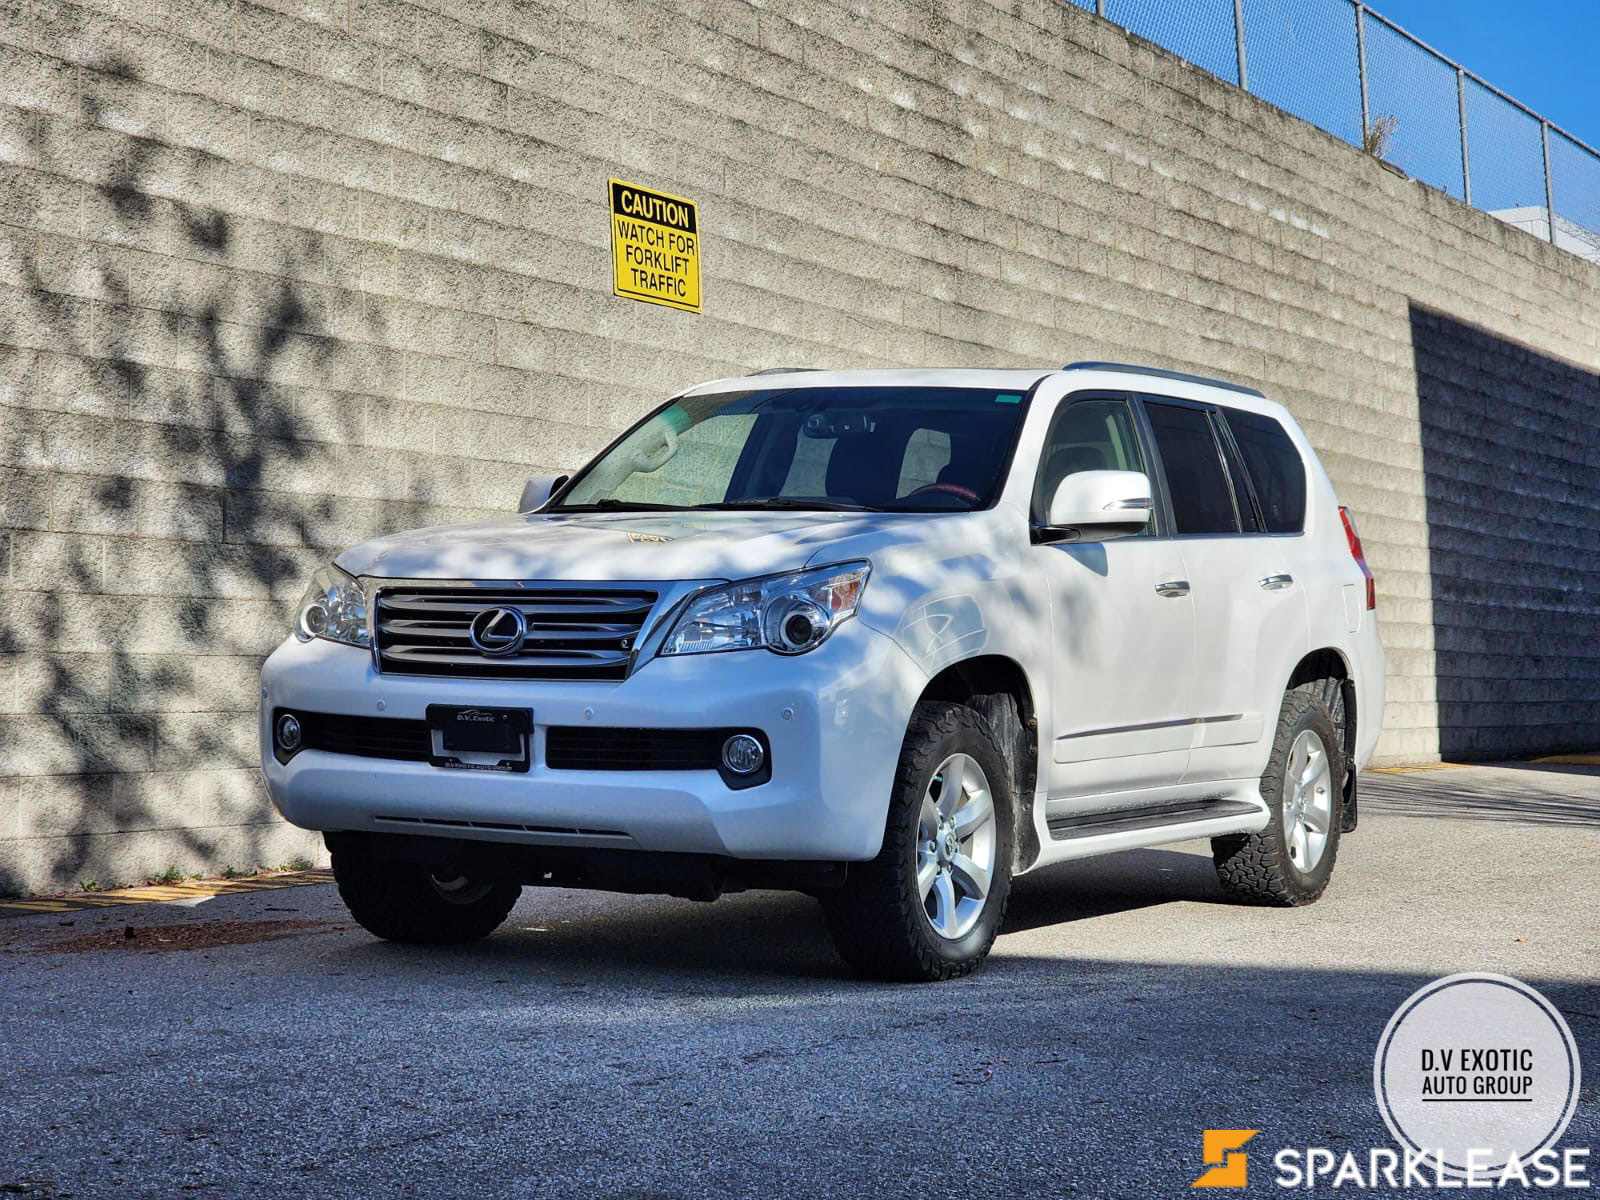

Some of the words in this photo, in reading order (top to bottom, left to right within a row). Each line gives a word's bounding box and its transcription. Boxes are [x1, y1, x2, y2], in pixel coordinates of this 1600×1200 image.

[621, 190, 689, 228] CAUTION
[617, 219, 665, 249] WATCH
[668, 233, 695, 256] FOR
[625, 245, 690, 276] FORKLIFT
[630, 268, 687, 297] TRAFFIC
